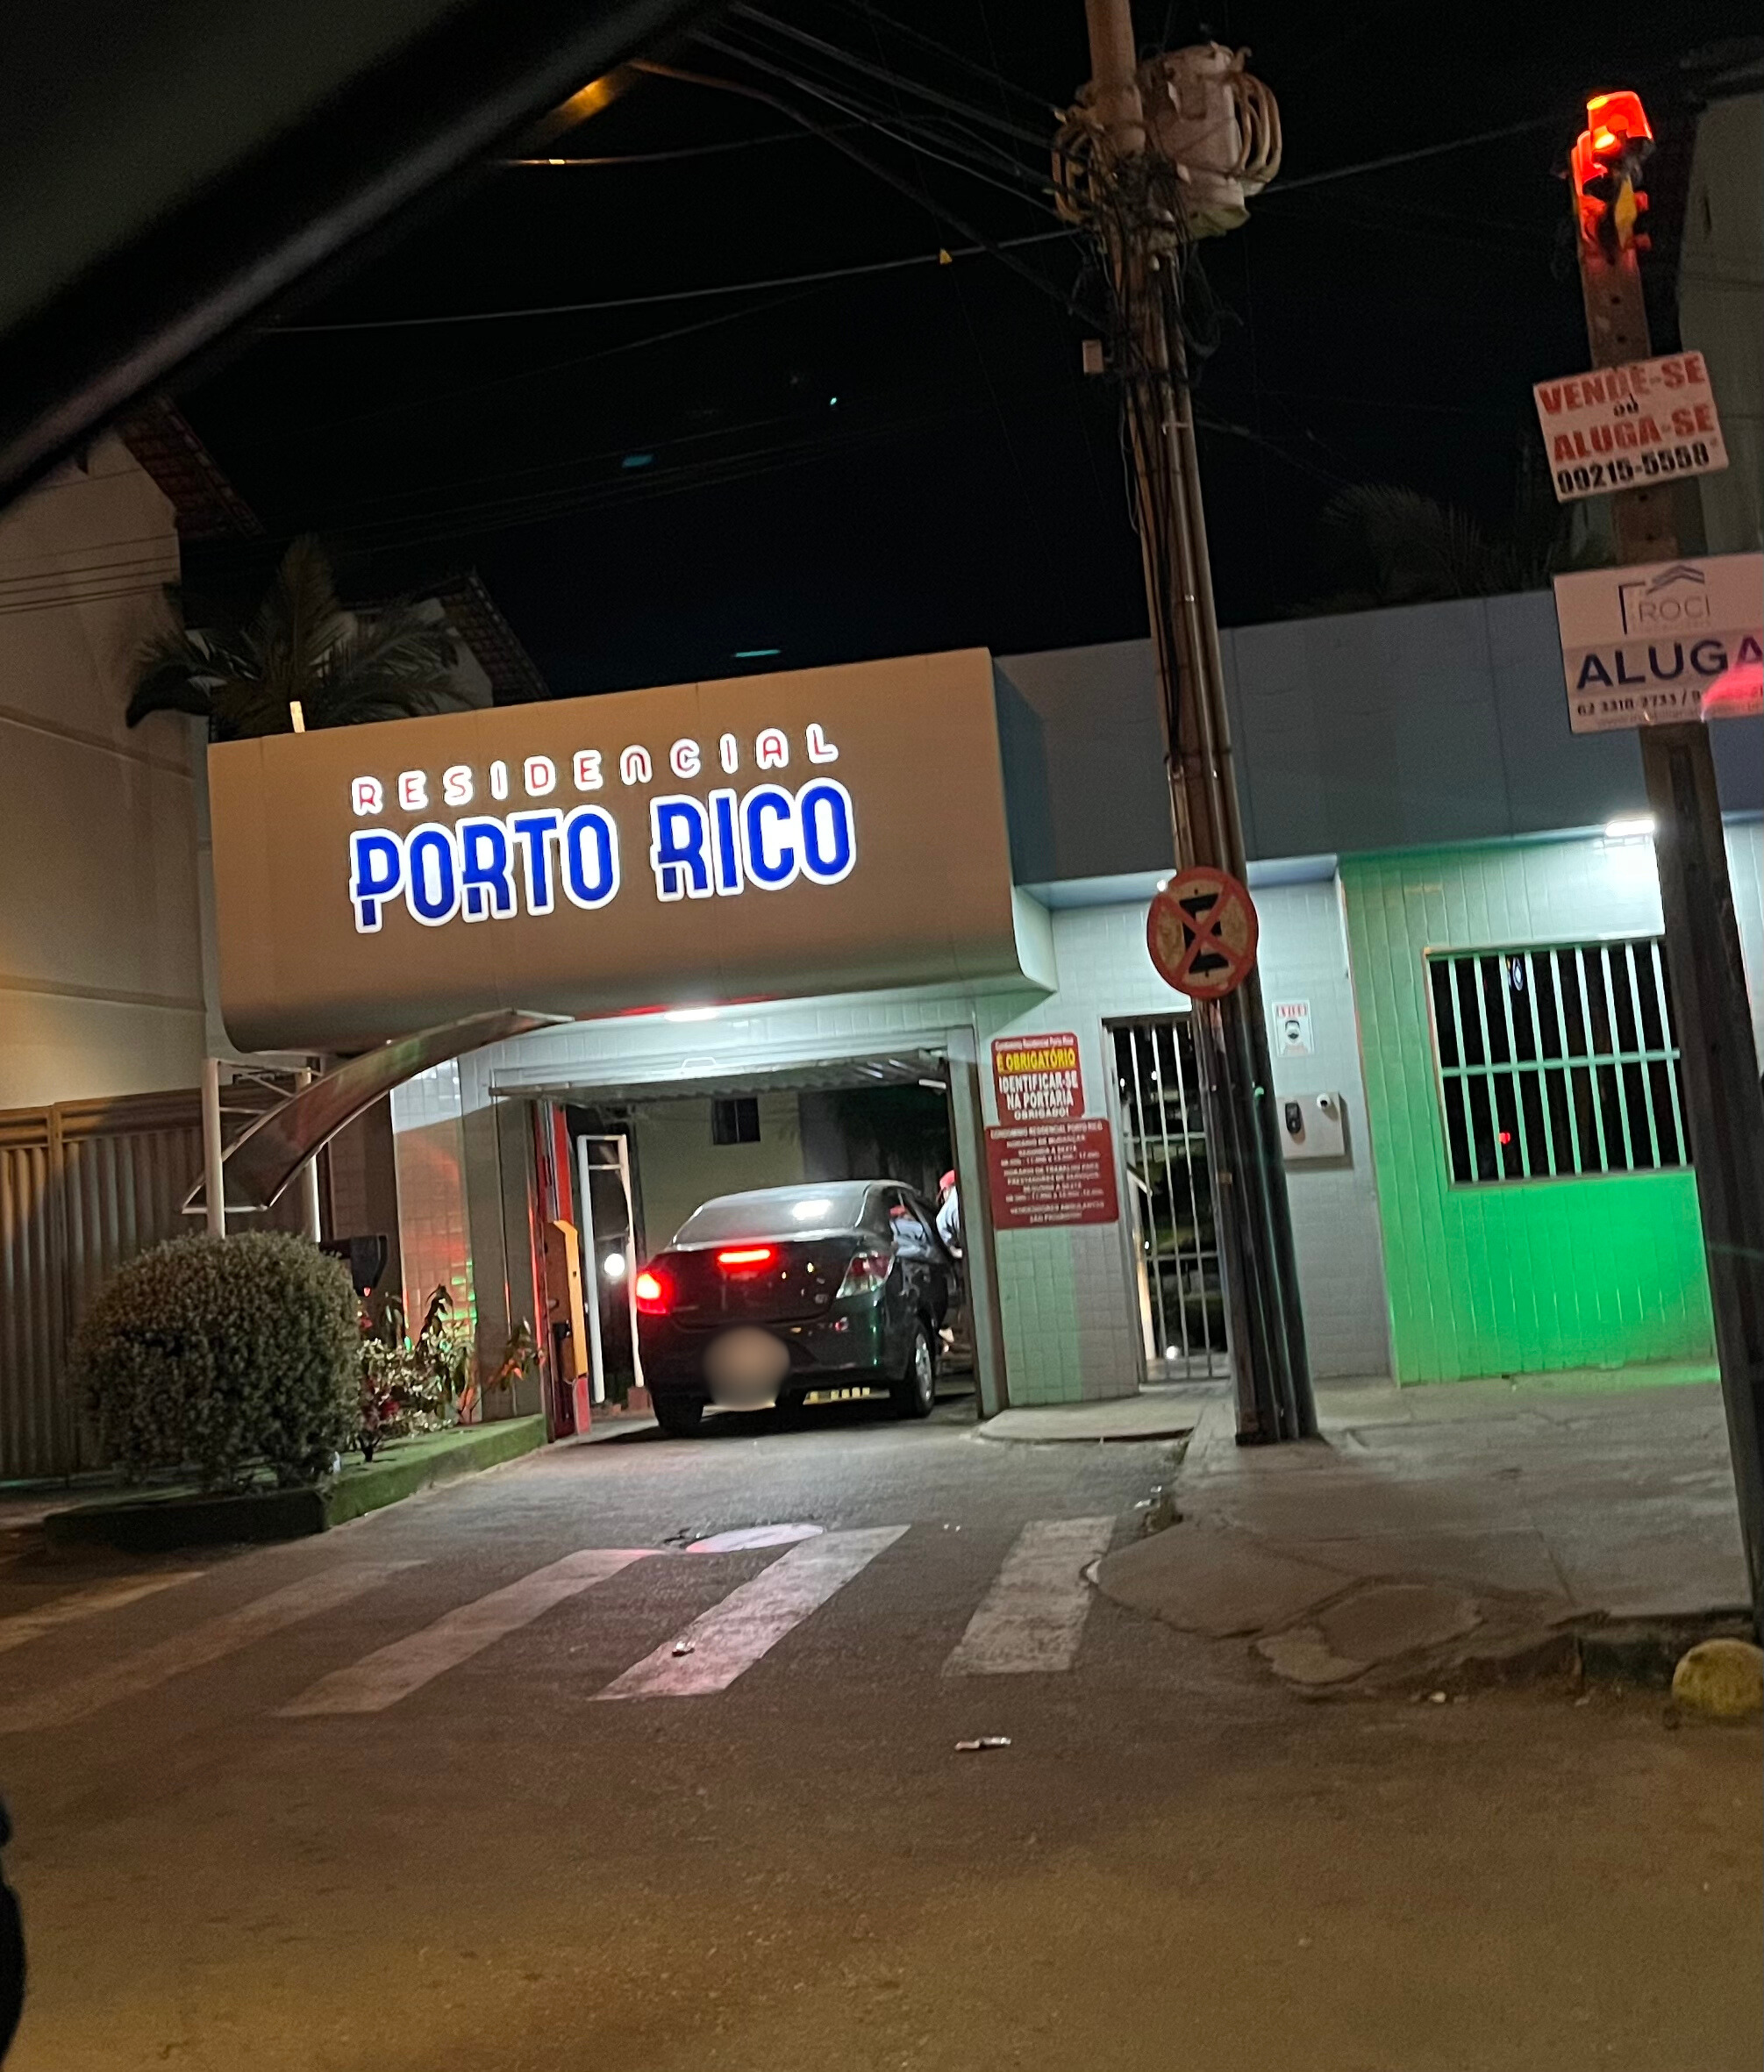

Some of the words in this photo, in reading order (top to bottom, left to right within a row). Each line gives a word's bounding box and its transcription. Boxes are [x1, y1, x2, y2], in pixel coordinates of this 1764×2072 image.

[1538, 354, 1706, 415] VENDE-SE
[1553, 403, 1714, 462] ALUGA-SE
[352, 723, 839, 816] RESIDENCIAL
[349, 804, 620, 933] PORTO
[650, 777, 855, 902] RICO
[999, 1070, 1079, 1093] IDENTIFICAR-SE
[1006, 1047, 1075, 1071] OBRIGATÓRIO
[1007, 1093, 1022, 1110] NA
[1024, 1090, 1074, 1109] PORTARIA
